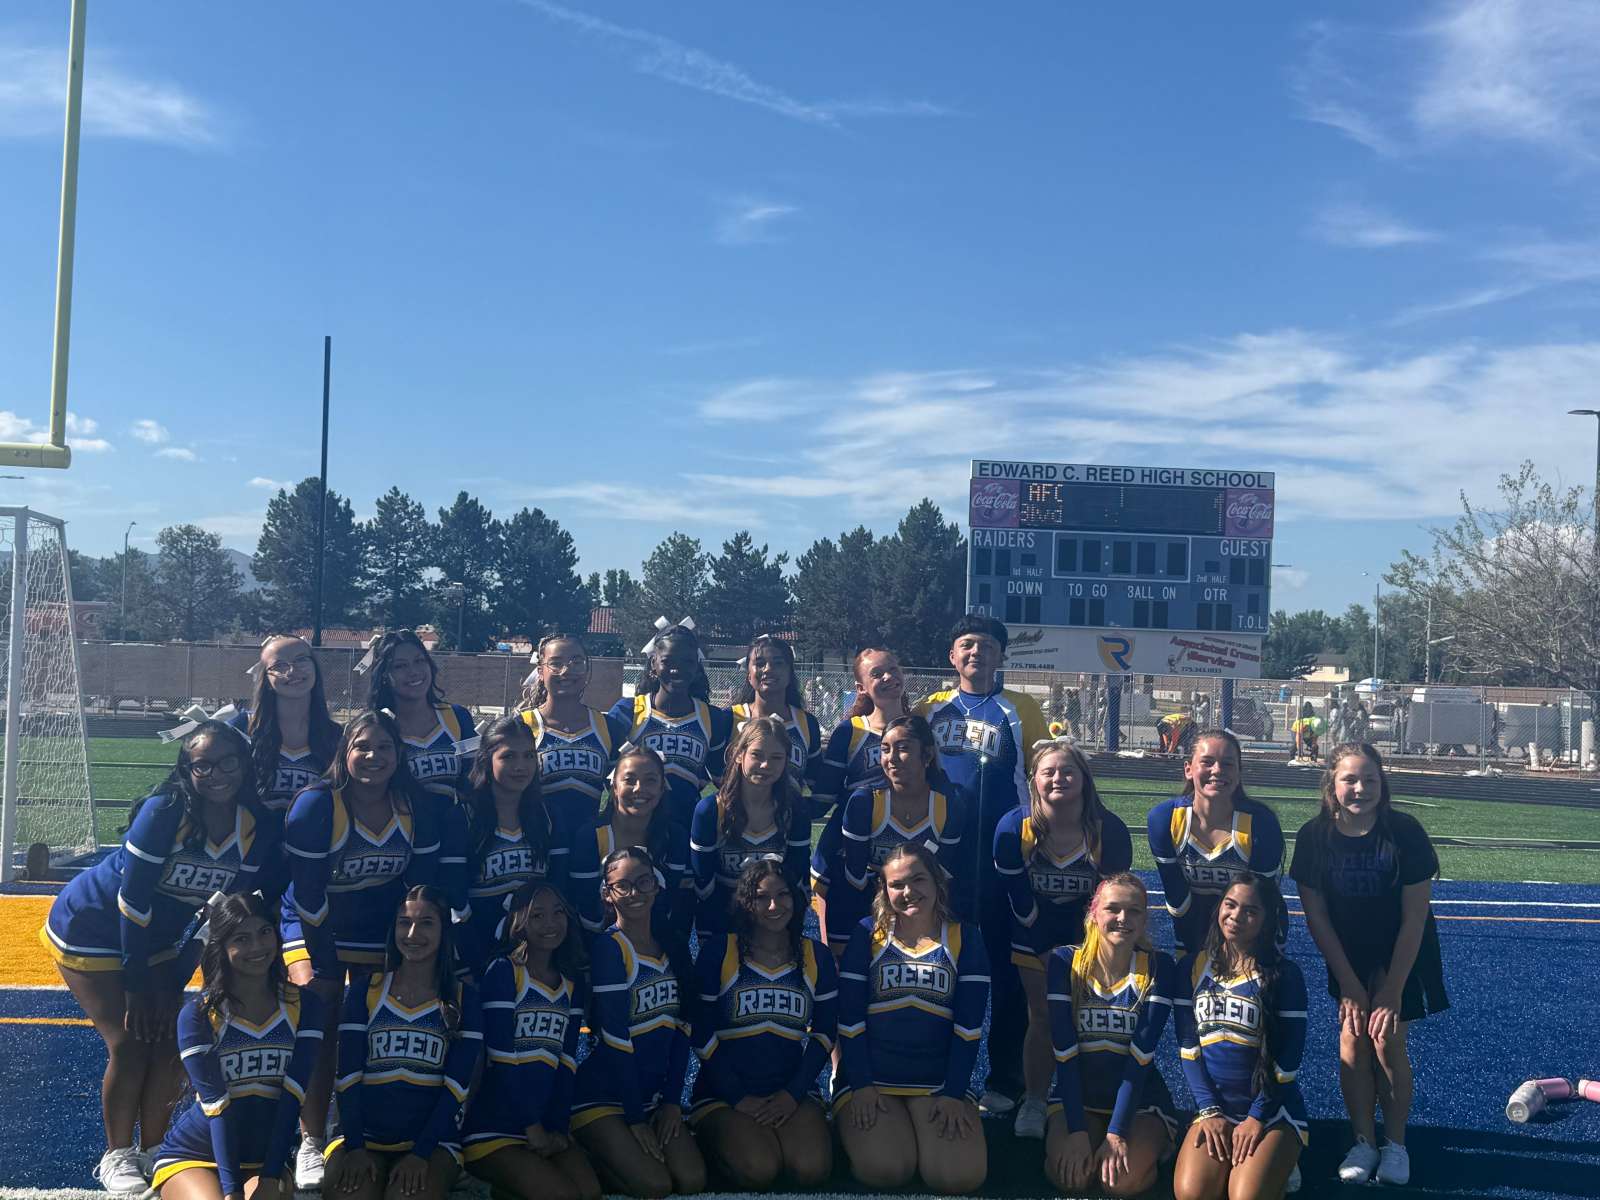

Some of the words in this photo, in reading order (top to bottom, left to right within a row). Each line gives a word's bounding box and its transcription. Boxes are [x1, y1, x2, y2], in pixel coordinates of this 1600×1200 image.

[979, 462, 1057, 480] EDWARD
[1063, 465, 1080, 480] C.
[1086, 467, 1135, 483] REED
[1141, 469, 1185, 485] HIGH
[1190, 471, 1267, 488] SCHOOL
[973, 530, 1036, 549] RAIDERS
[1220, 539, 1268, 557] GUEST
[1027, 567, 1044, 578] HALF
[1211, 575, 1227, 585] HALF
[1007, 581, 1043, 595] DOWN
[1068, 583, 1082, 596] TO
[1092, 584, 1108, 597] GO
[1162, 586, 1176, 600] ON
[1237, 615, 1267, 630] T.O.L.
[646, 734, 704, 759] REED
[542, 750, 602, 774] REED
[1032, 872, 1093, 894] REED
[880, 962, 951, 994] REED
[636, 979, 681, 1013] REE
[737, 987, 806, 1018] REED
[1076, 1008, 1138, 1034] REED
[371, 1029, 443, 1066] REED
